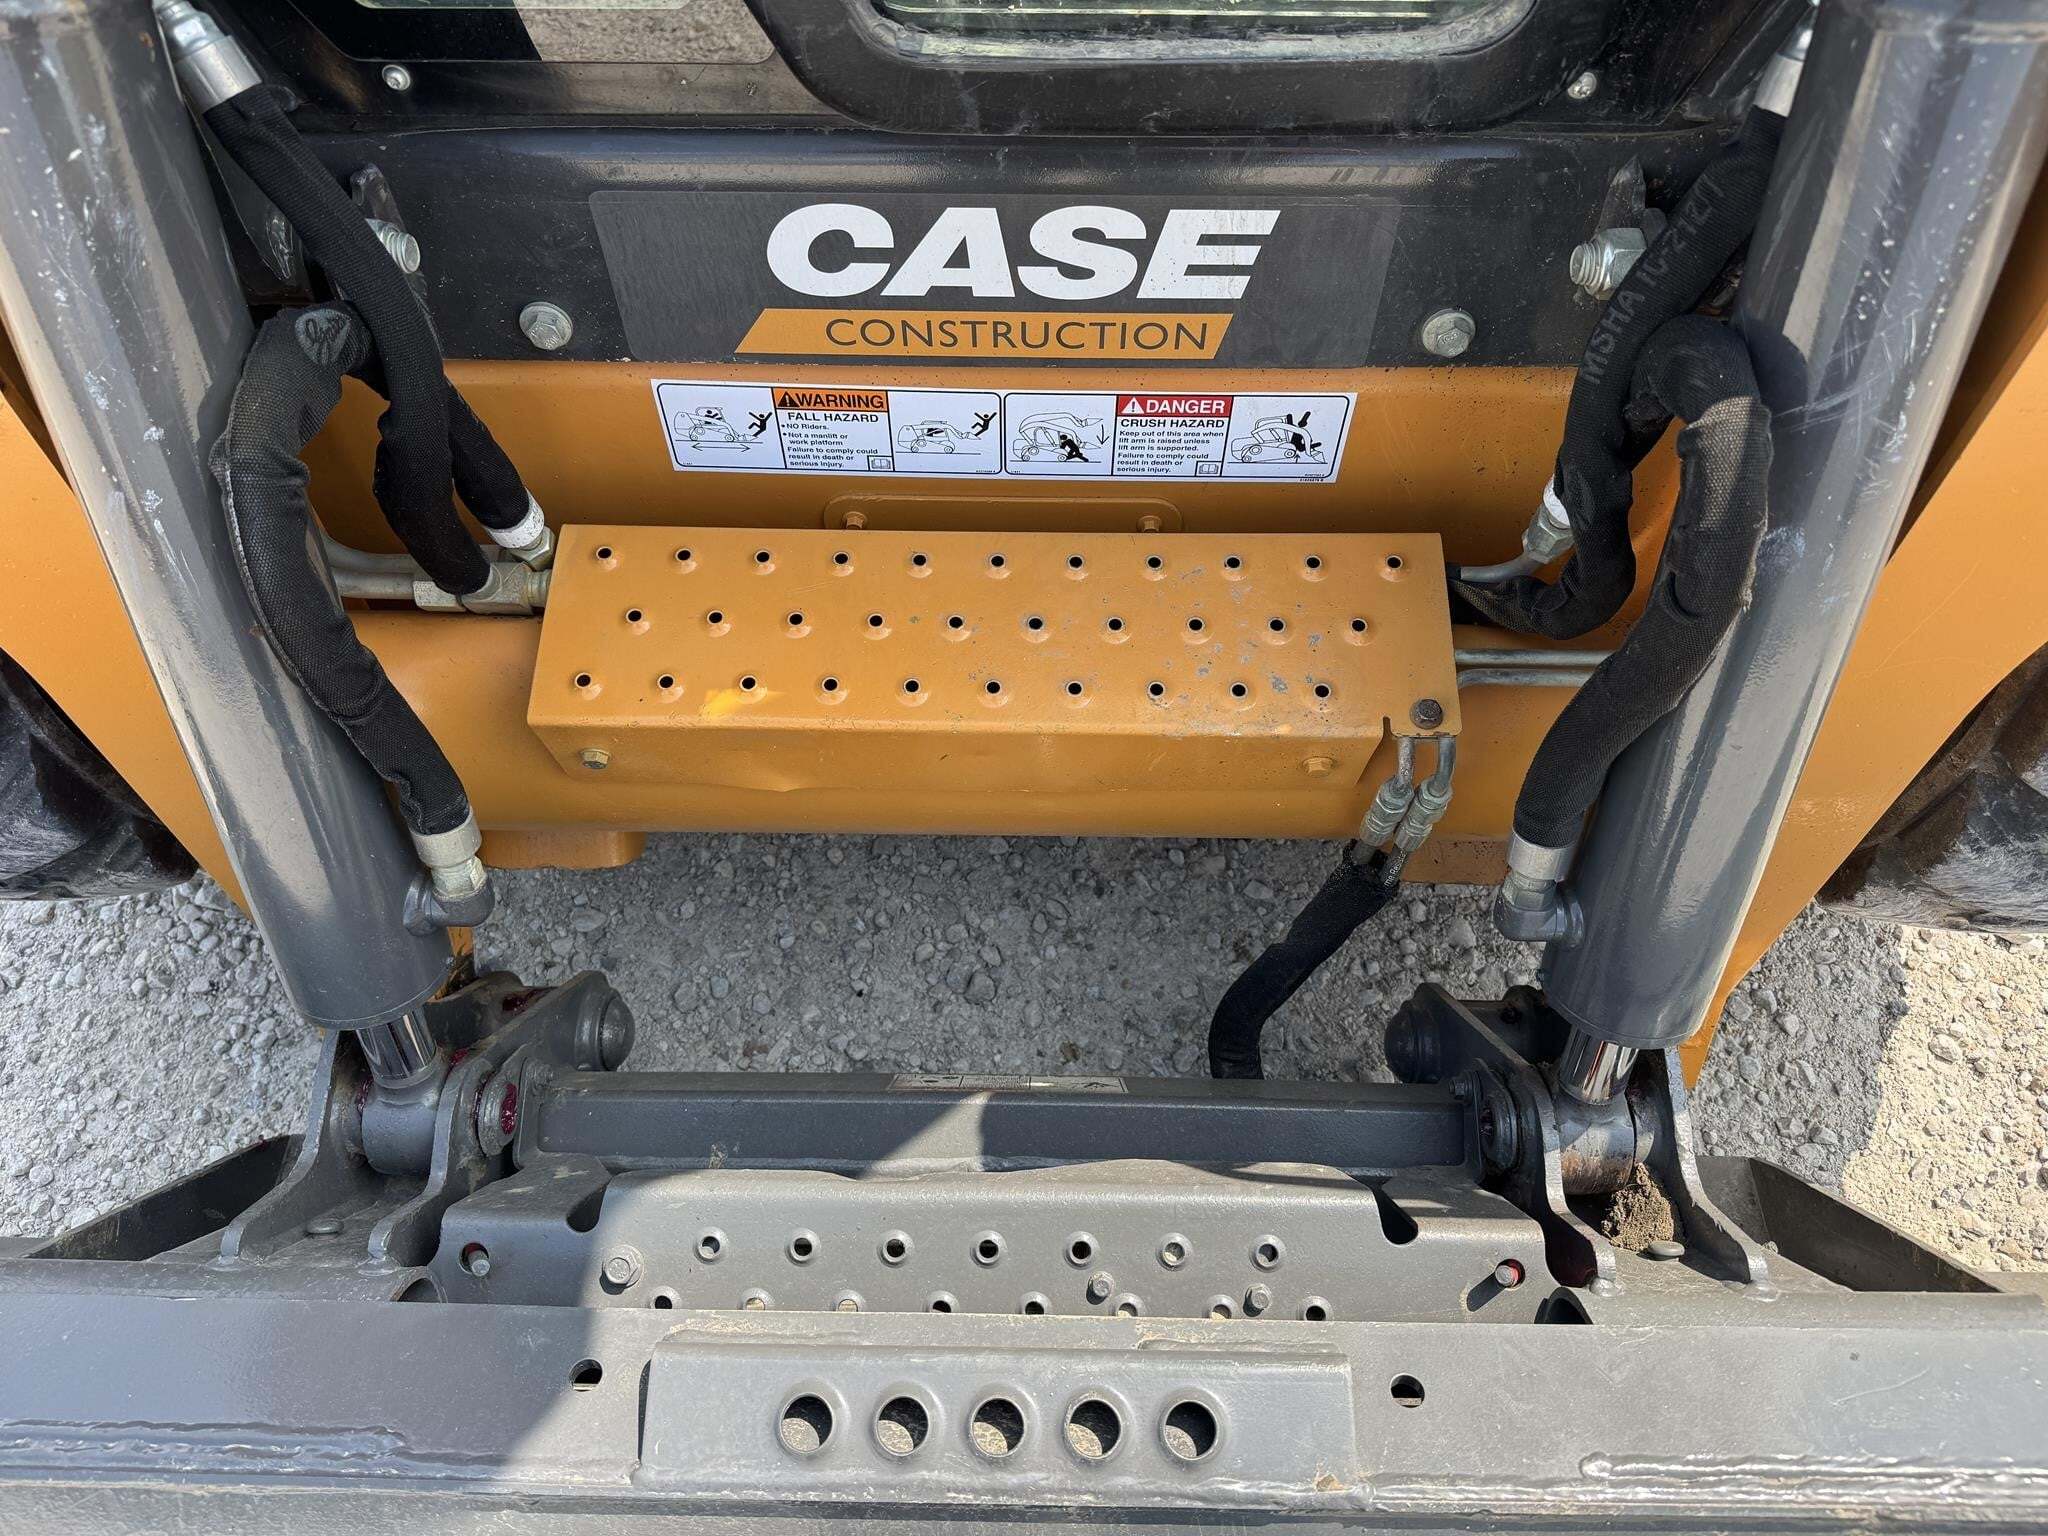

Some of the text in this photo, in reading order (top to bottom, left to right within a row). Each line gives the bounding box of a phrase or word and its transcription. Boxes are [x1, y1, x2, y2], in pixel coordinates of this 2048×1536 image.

[766, 203, 1281, 299] CASE
[825, 318, 1208, 350] CONSTRUCTION
[1581, 289, 1646, 385] MSHA
[795, 393, 884, 408] WARNING
[1146, 400, 1226, 414] DANGER
[788, 412, 879, 423] FALL HAZARD
[1120, 418, 1225, 428] CRUSH HAZARD
[1119, 430, 1140, 438] Keep
[1156, 453, 1185, 461] comply
